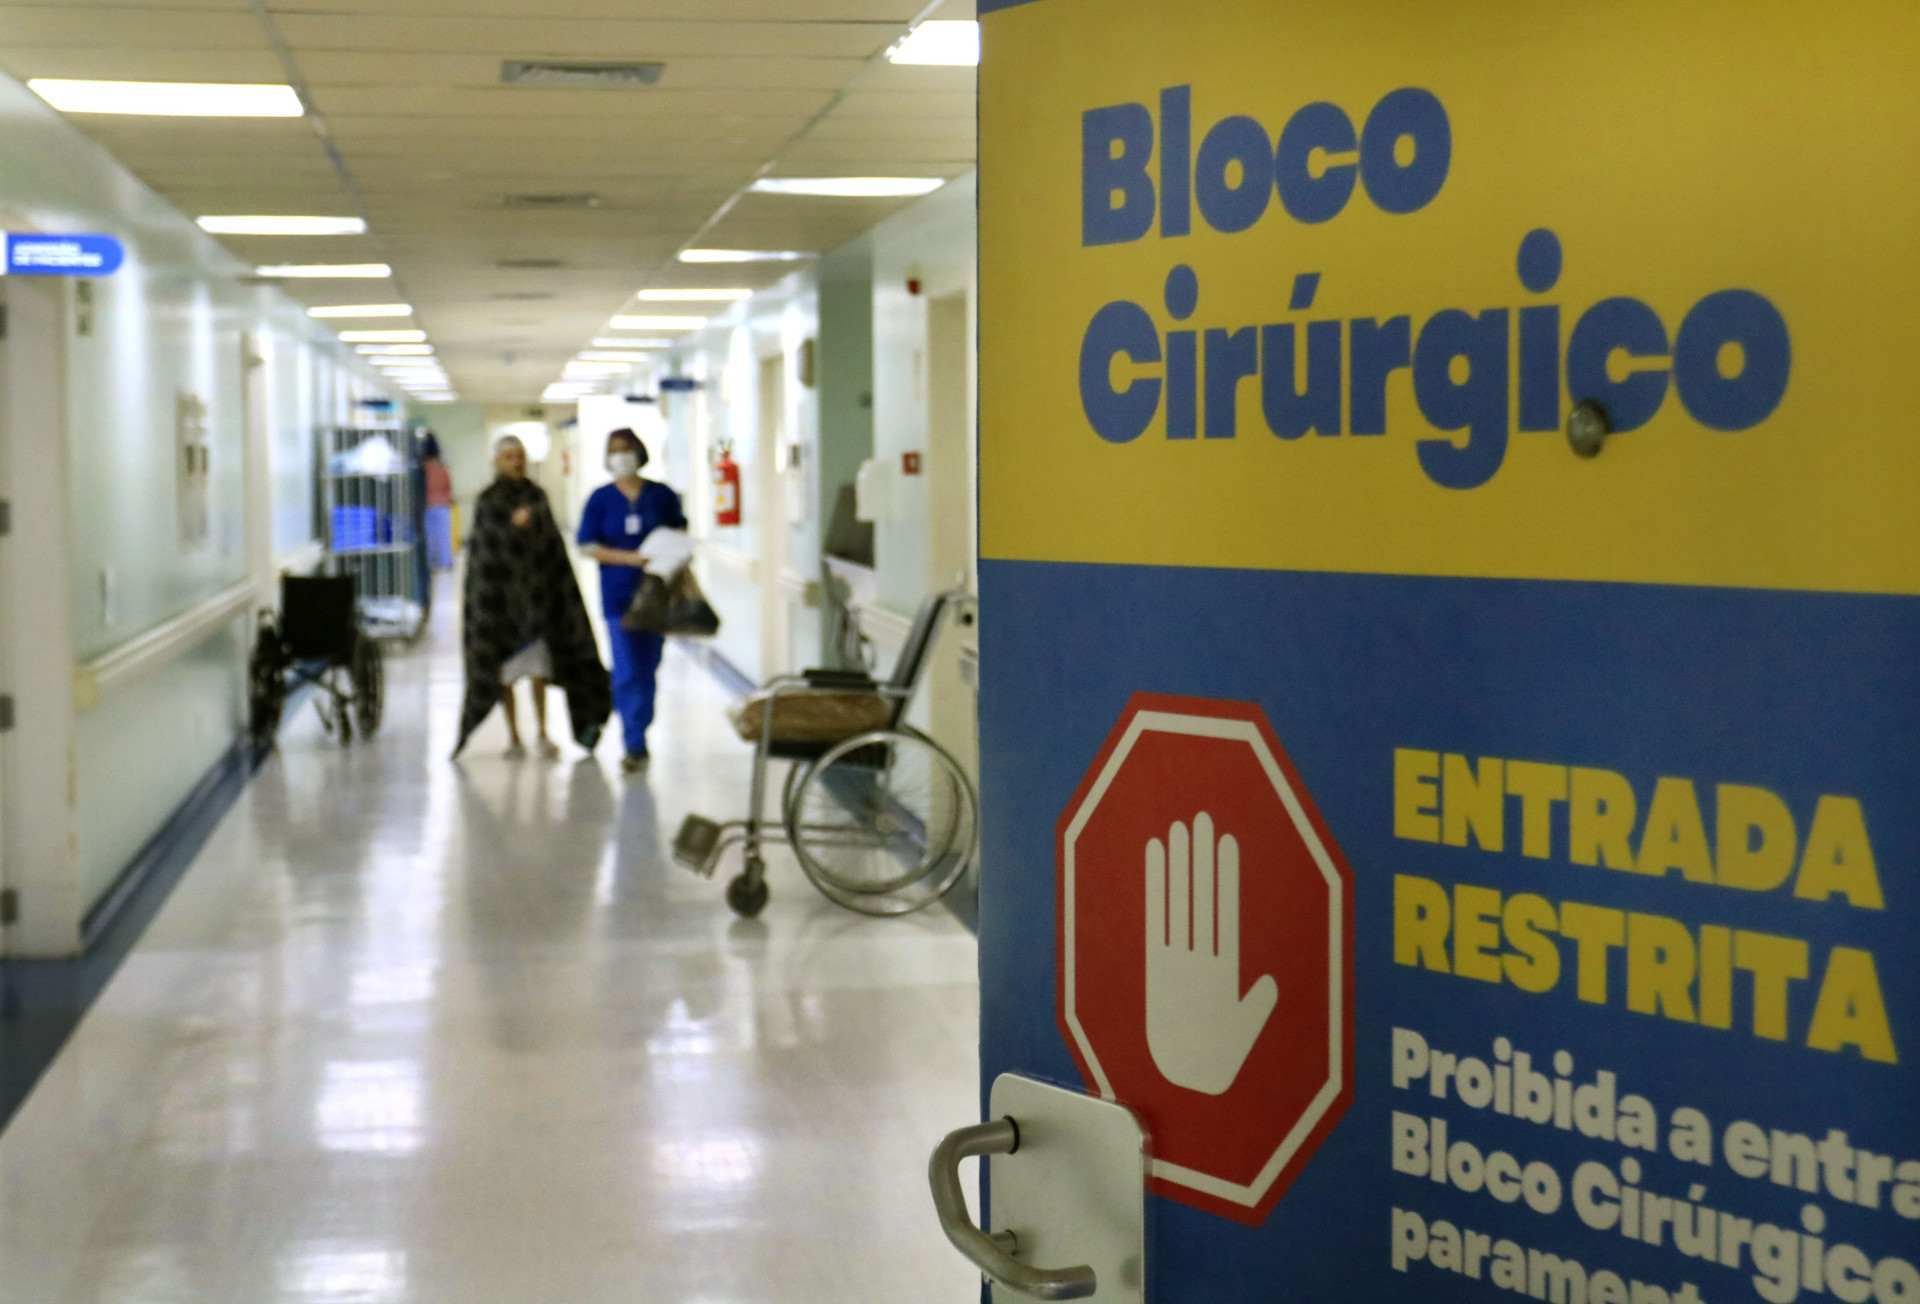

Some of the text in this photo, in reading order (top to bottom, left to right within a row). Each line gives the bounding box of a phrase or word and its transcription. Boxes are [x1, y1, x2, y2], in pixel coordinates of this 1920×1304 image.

[1081, 84, 1452, 248] Bloco
[1079, 227, 1792, 491] Cirúrgico
[1394, 748, 1885, 910] ENTRADA
[1394, 873, 1899, 1065] RESTRITA
[1391, 1026, 1920, 1220] Proibida a entra
[1391, 1110, 1920, 1304] Bloco Cirúrgico
